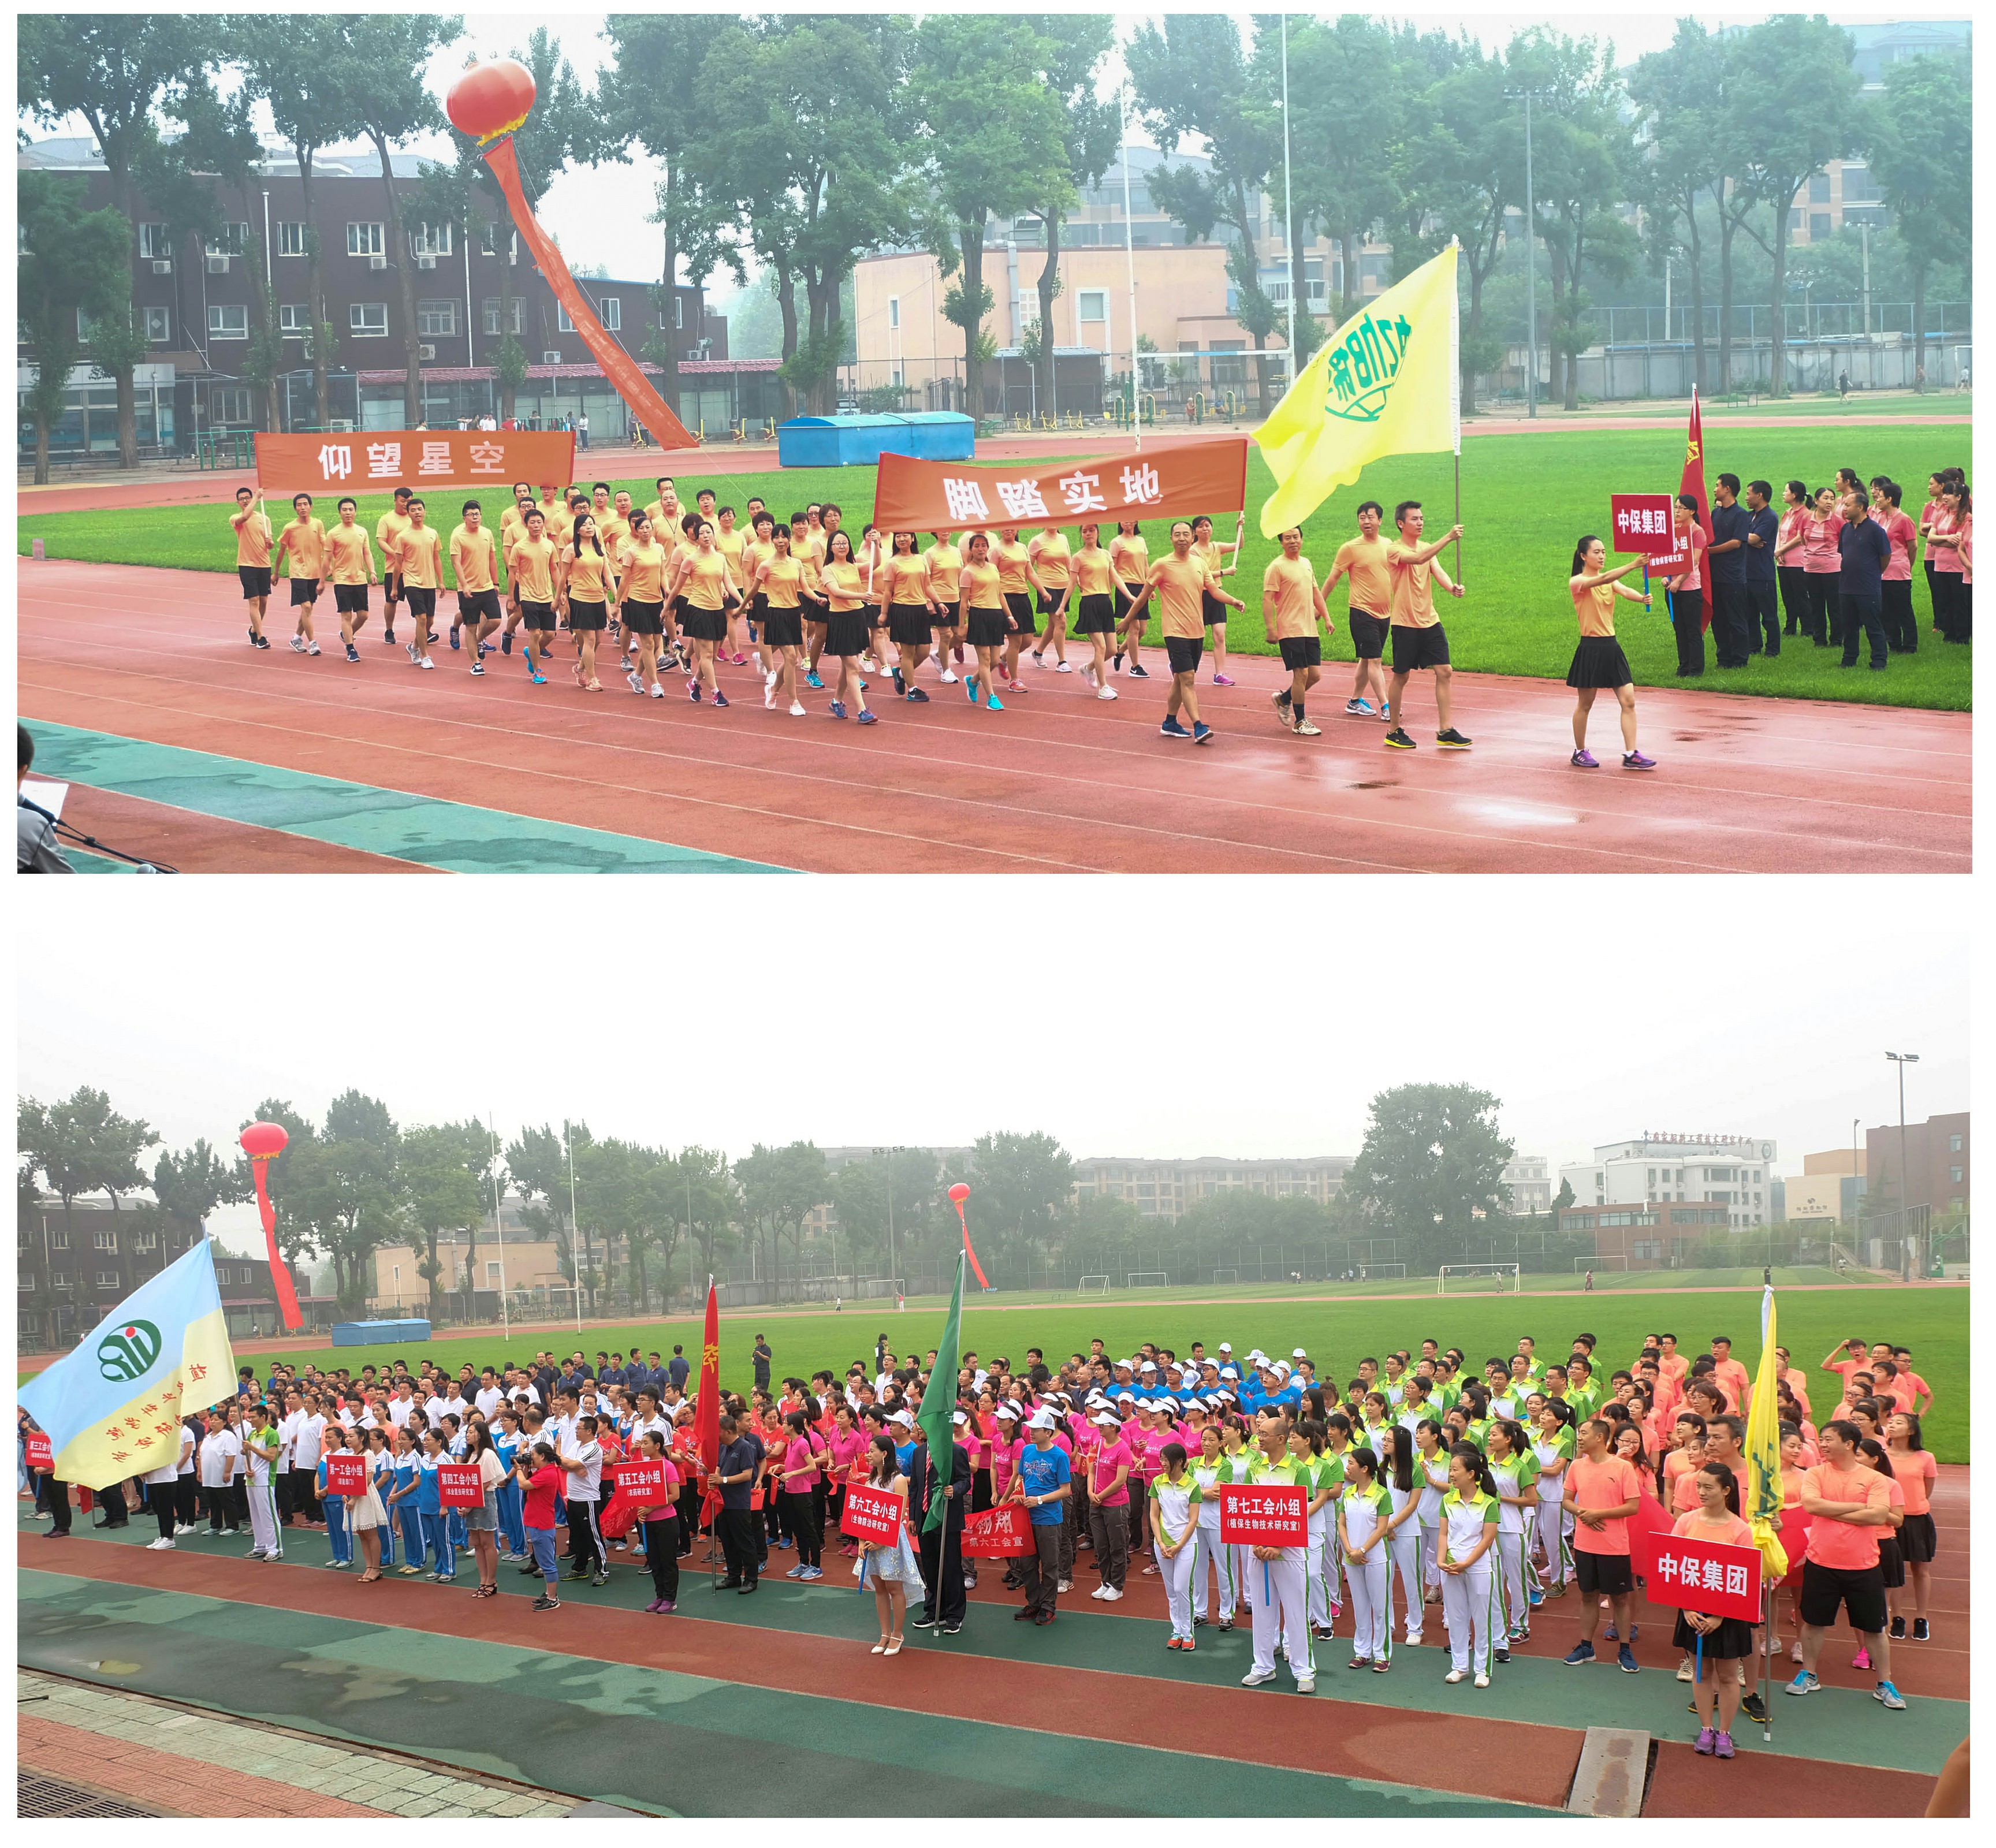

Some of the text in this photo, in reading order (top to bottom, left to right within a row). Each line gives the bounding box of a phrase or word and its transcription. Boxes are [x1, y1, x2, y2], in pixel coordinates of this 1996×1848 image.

[318, 441, 505, 480] 仰望星空
[943, 463, 1163, 521] 脚踏实地
[1618, 509, 1667, 535] 中保集团
[329, 1463, 363, 1476] 第一工会小组
[441, 1473, 479, 1485] 第四工会小组
[618, 1470, 661, 1486] 第五工会小组
[848, 1493, 897, 1521] 第六工会小组
[1227, 1496, 1301, 1516] 第七工会小组
[851, 1514, 889, 1533] (生物防治研究室)
[1227, 1518, 1300, 1531] (植保生物技术研究室)
[969, 1536, 1023, 1547] 第六工会宣
[1658, 1552, 1748, 1597] 中保集团
